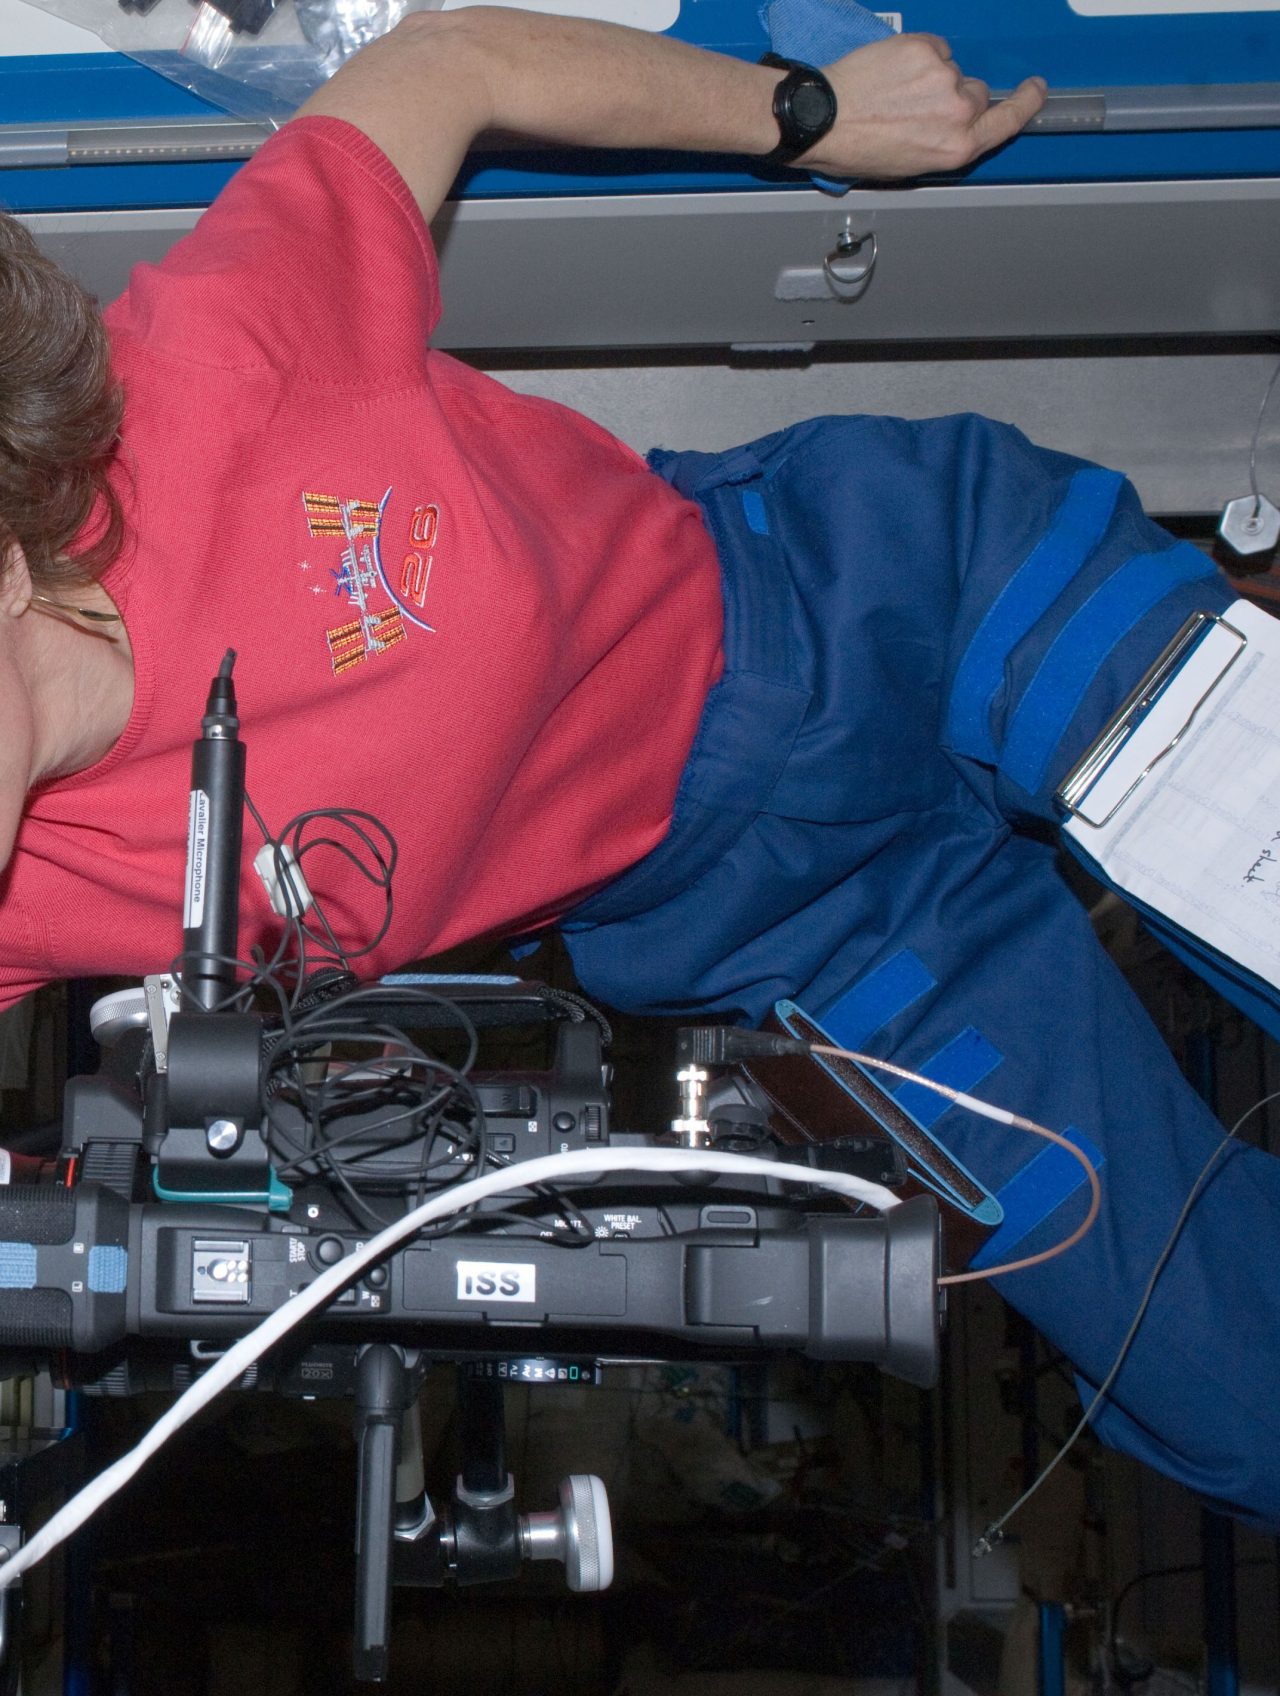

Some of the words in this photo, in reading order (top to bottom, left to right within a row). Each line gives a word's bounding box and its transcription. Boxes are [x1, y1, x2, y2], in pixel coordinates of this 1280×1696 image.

[400, 503, 440, 608] 26
[194, 838, 206, 903] Microphone
[604, 1214, 626, 1222] WHITE
[610, 1222, 635, 1230] PRESET
[298, 1242, 306, 1262] STOP
